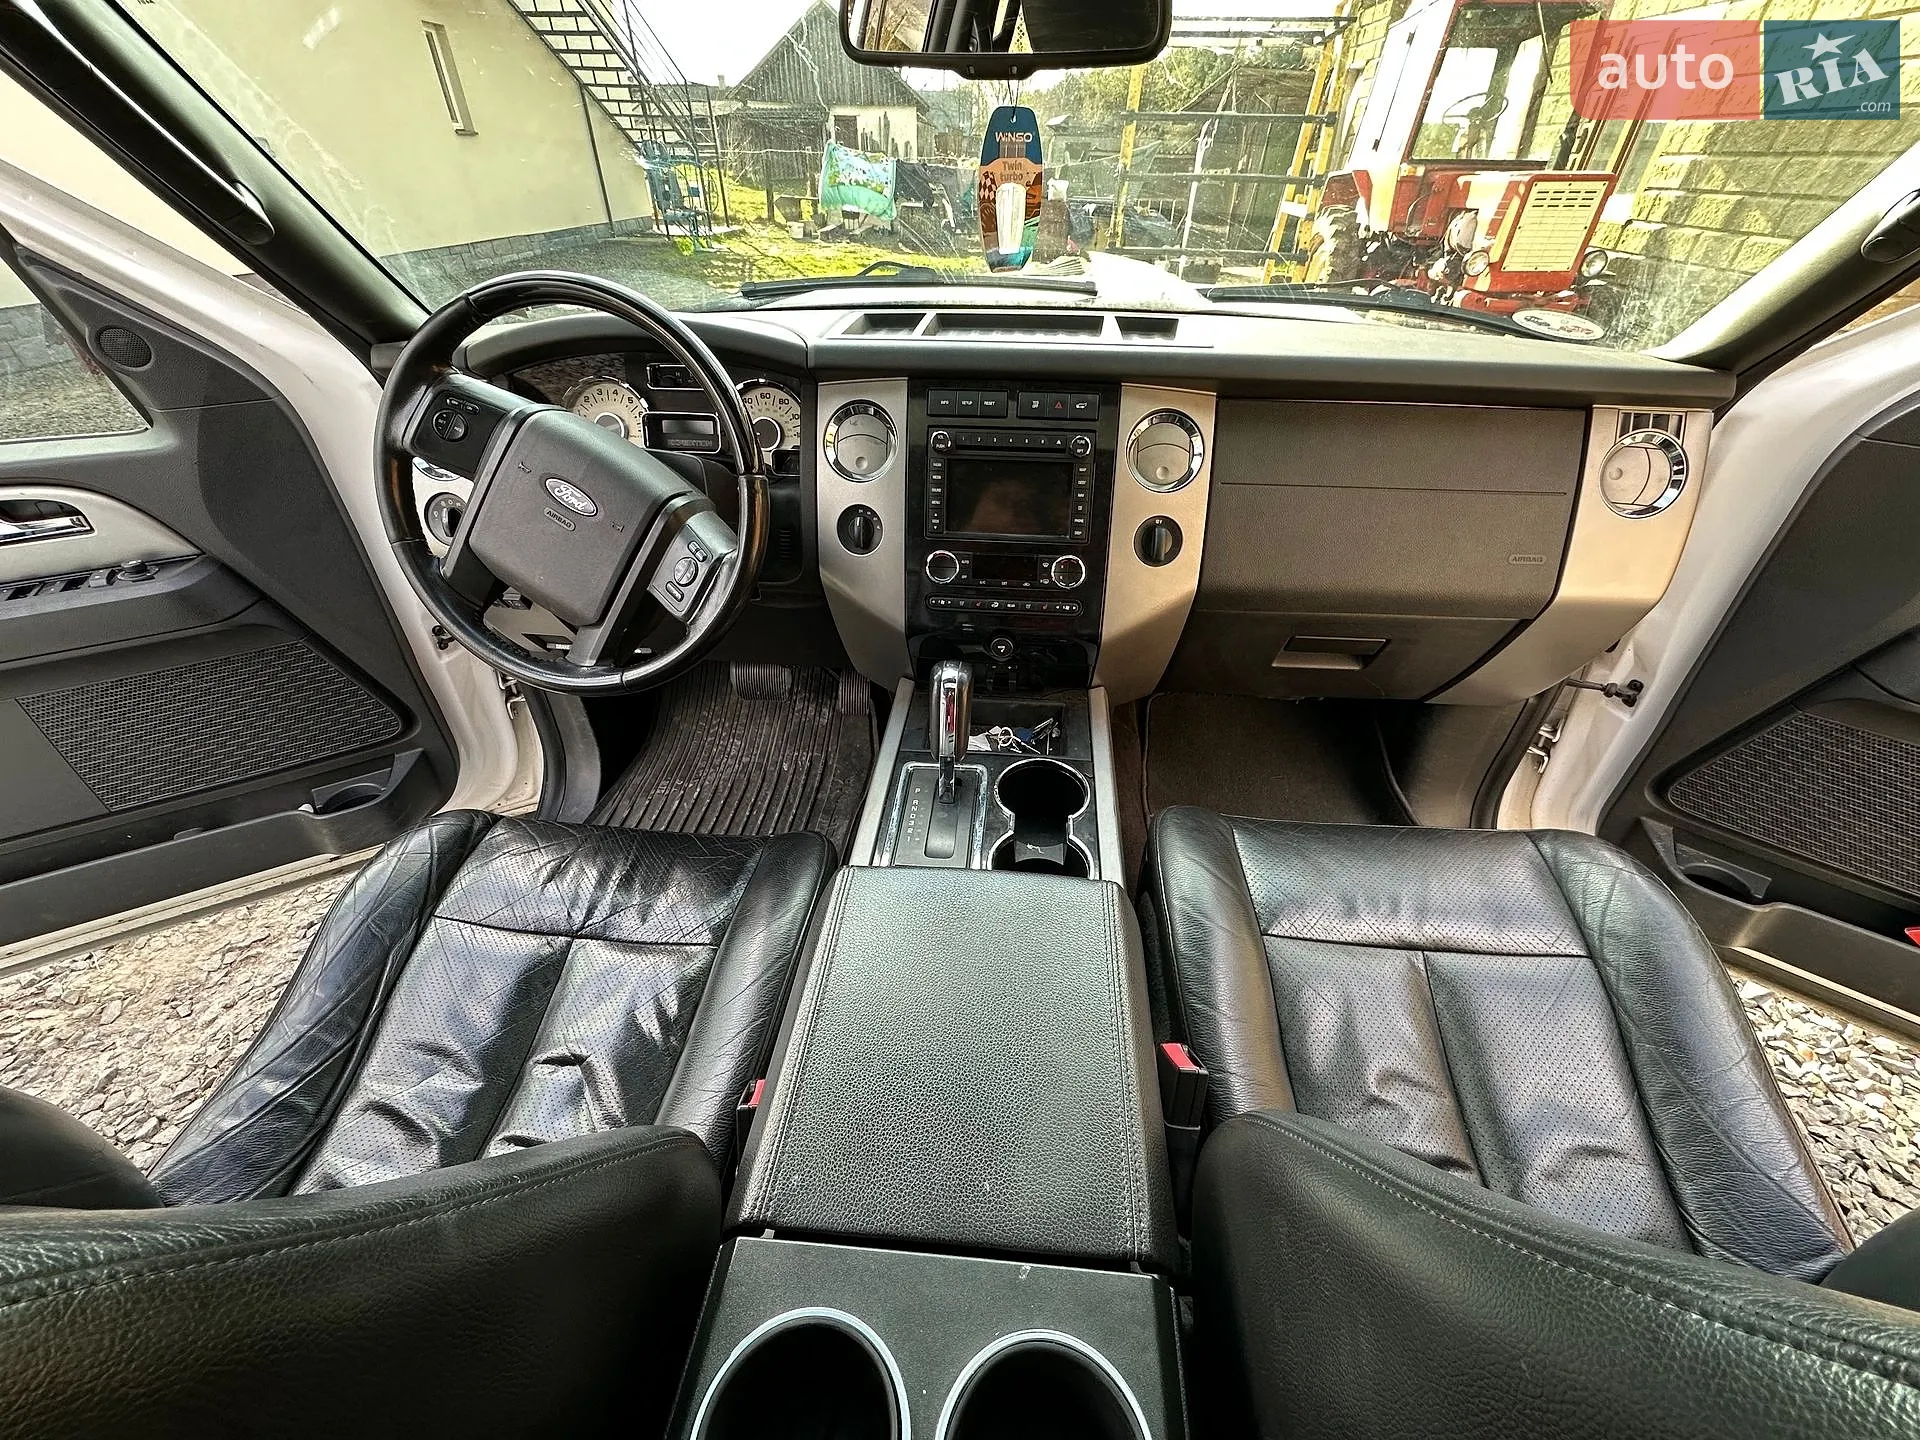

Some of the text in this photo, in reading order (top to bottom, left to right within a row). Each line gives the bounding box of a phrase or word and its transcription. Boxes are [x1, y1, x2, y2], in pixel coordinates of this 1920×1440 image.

[1003, 160, 1022, 170] Twin
[1000, 172, 1023, 181] turbo
[612, 389, 619, 397] 4
[583, 395, 590, 403] 2
[627, 396, 634, 404] 5
[554, 484, 588, 511] Ford
[546, 510, 573, 529] AIRBAG
